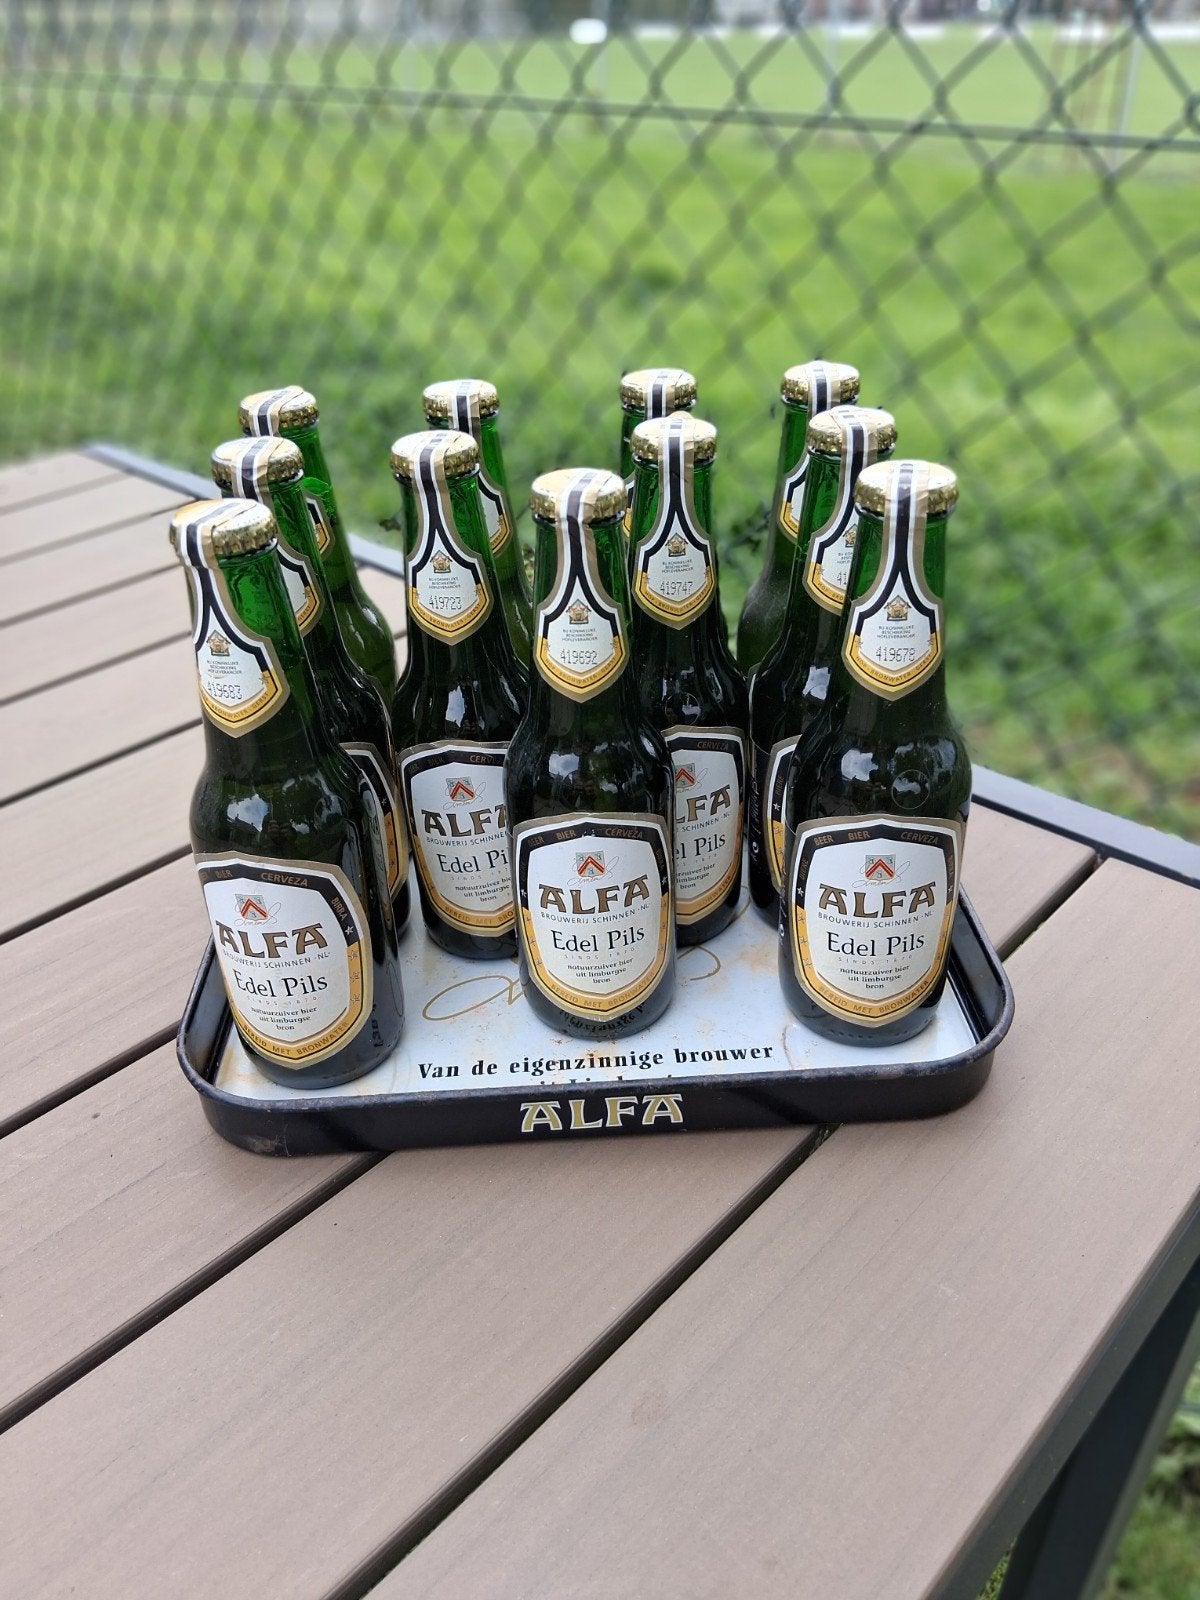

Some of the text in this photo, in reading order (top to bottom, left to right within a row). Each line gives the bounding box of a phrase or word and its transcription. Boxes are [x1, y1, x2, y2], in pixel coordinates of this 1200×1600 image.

[661, 581, 693, 595] 419747
[429, 595, 462, 610] 419723
[560, 649, 598, 664] 419692
[876, 646, 916, 662] 419678
[676, 784, 731, 824] FA
[682, 818, 719, 832] SCHINNEN
[426, 836, 468, 847] BROUWERIJ
[556, 829, 576, 840] BIER
[604, 828, 643, 839] CERVEZA
[813, 834, 834, 846] BEER
[847, 831, 871, 841] BIER
[900, 831, 939, 845] CERVEZA
[693, 833, 726, 857] Pils
[436, 849, 509, 873] Edel Pi
[680, 882, 697, 890] bron
[215, 870, 232, 879] BIER
[260, 872, 309, 887] CERVEZA
[331, 896, 347, 921] BIRRA
[538, 874, 650, 915] ALFA
[818, 881, 937, 919] ALFA
[541, 911, 589, 924] BROUWERIJ
[592, 909, 636, 924] SCHINNEN
[818, 912, 870, 928] BROUWERIJ
[873, 916, 919, 929] SCHINNEN
[216, 920, 328, 959] ALFA
[551, 926, 645, 952] Edel Pils
[826, 931, 925, 957] Edel Pils
[264, 956, 311, 969] SCHINNEN
[567, 957, 634, 971] natuurzuiver bier
[839, 964, 910, 975] natuurzuiver bier
[232, 969, 328, 998] Edel Pils
[848, 974, 860, 982] uit
[853, 1004, 873, 1014] MET
[878, 979, 929, 1013] BRONWATER
[271, 1015, 311, 1024] limburgse
[272, 1045, 291, 1055] MET
[418, 1045, 774, 1079] Van de eigenzinnige brouwer
[520, 1093, 683, 1133] ALFA
